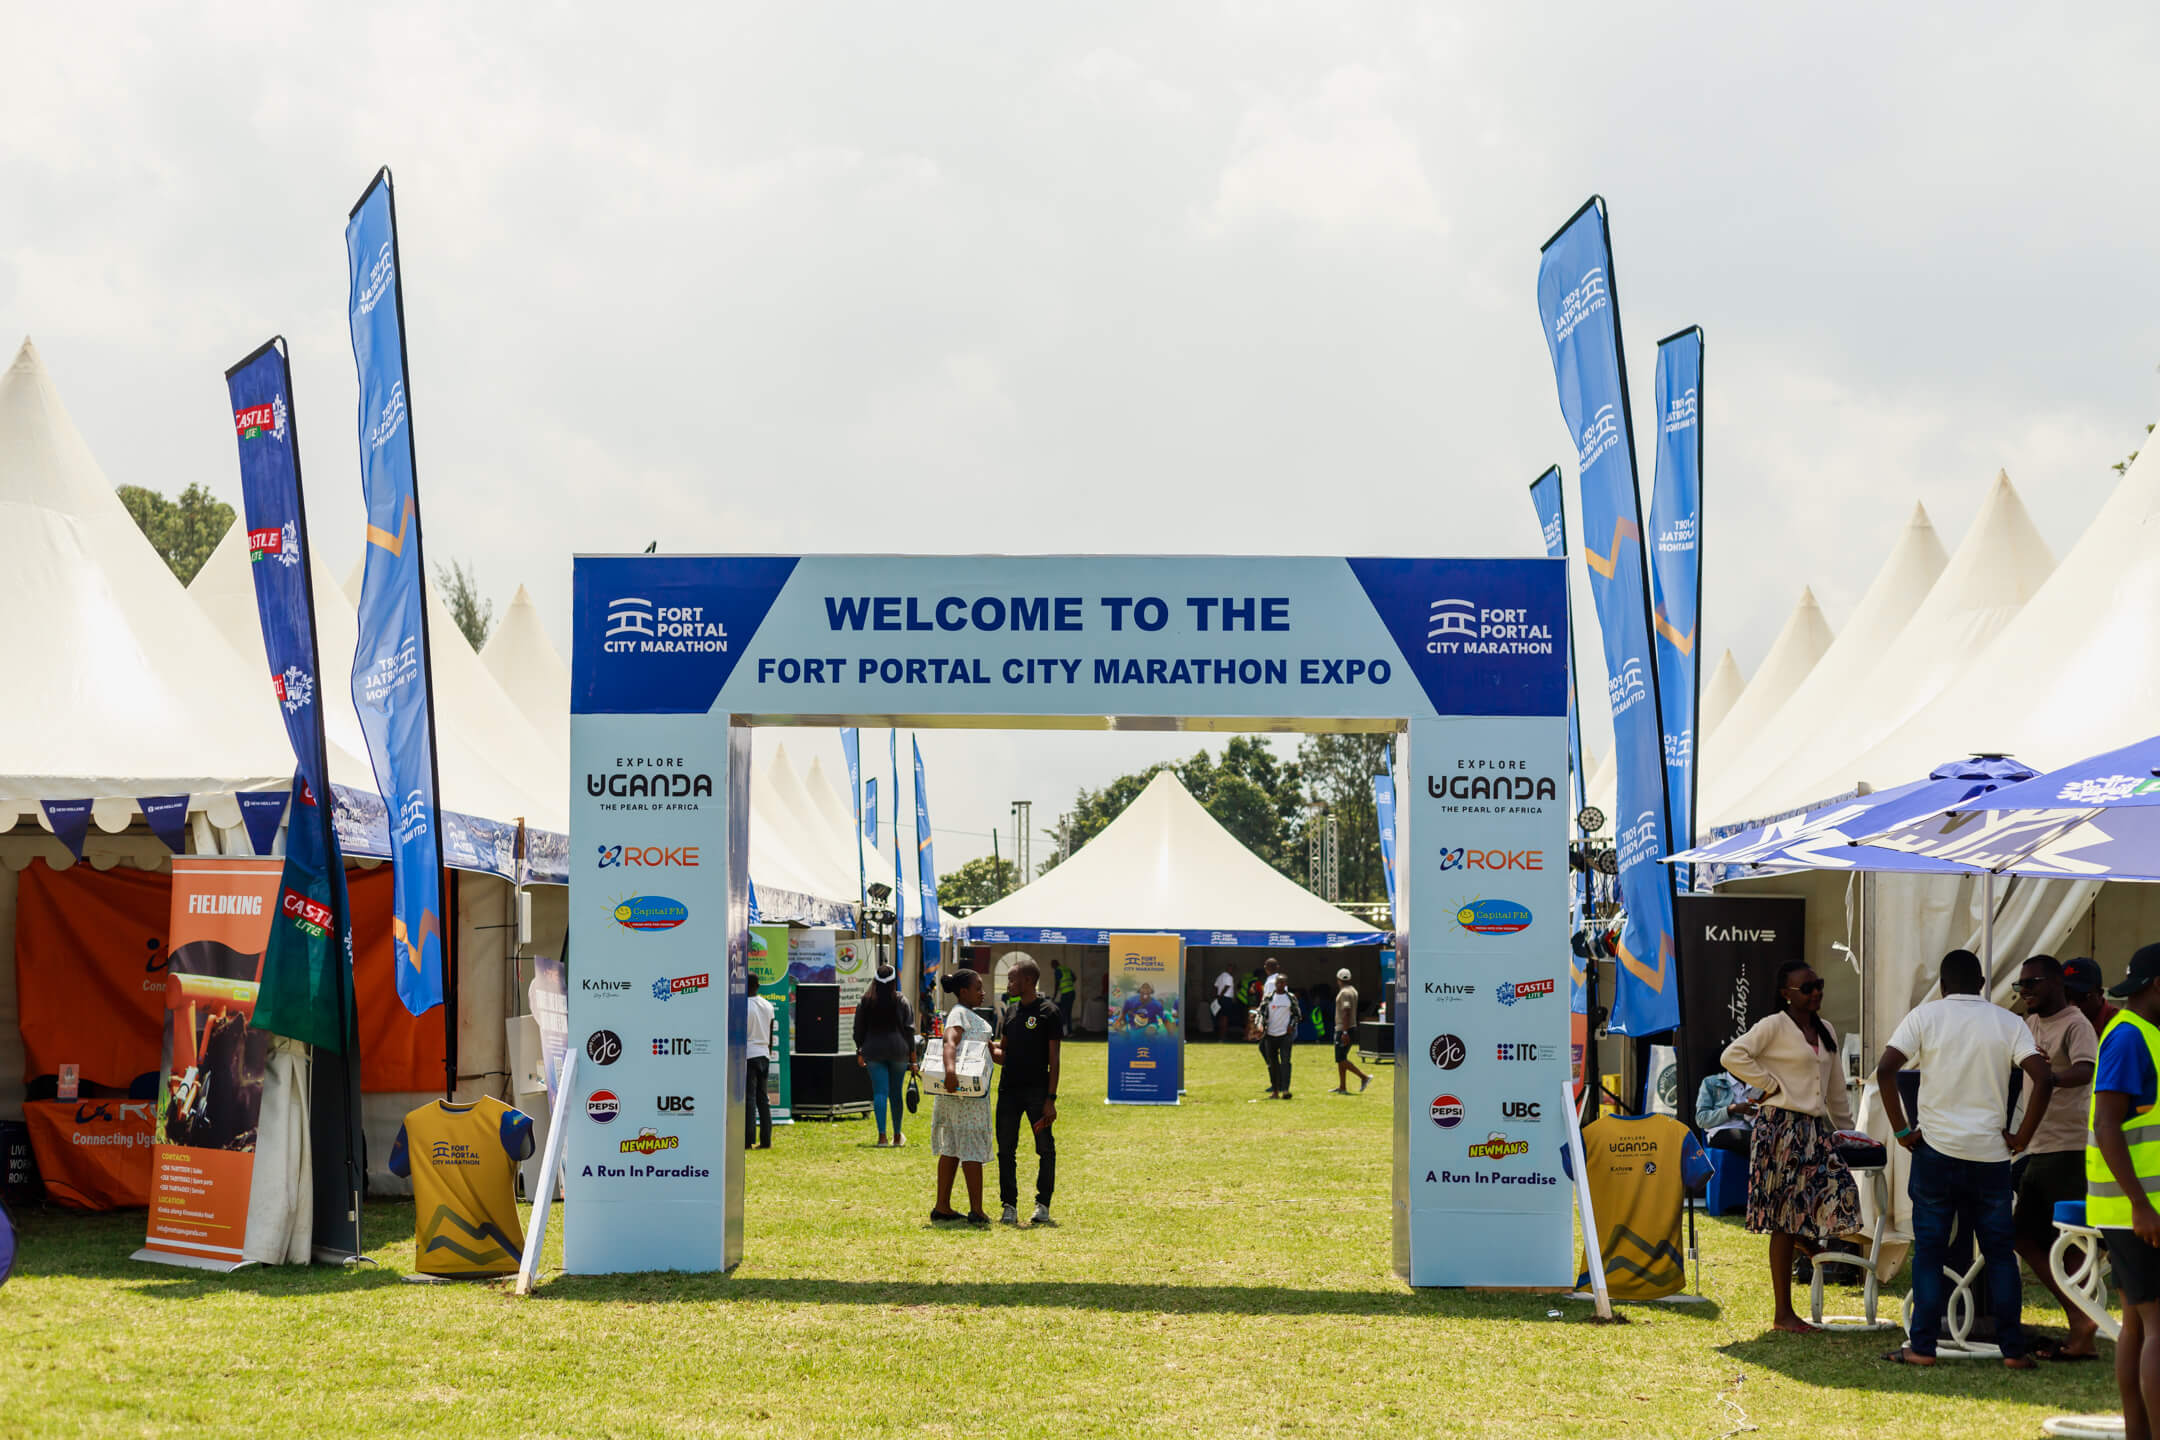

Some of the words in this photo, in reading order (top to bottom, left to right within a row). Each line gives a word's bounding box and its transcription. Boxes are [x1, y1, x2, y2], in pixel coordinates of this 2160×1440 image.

[657, 607, 704, 622] FORT
[824, 596, 1083, 632] WELCOME
[1101, 596, 1169, 632] TO
[1186, 597, 1291, 632] THE
[1480, 608, 1527, 623] FORT
[657, 622, 728, 638] PORTAL
[1480, 623, 1552, 640] PORTAL
[604, 640, 637, 653] CITY
[640, 640, 728, 653] MARATHON
[1426, 641, 1460, 655] CITY
[1463, 641, 1553, 655] MARATHON
[758, 657, 847, 684] FORT
[858, 657, 991, 685] PORTAL
[1002, 657, 1081, 685] CITY
[1093, 658, 1287, 685] MARATHON
[1299, 658, 1392, 686] EXPO
[616, 758, 684, 767] EXPLORE
[1457, 759, 1527, 769] EXPLORE
[587, 774, 712, 797] UGANDA
[1428, 775, 1556, 801] UGANDA
[624, 846, 699, 867] ROKE
[1466, 849, 1544, 870] ROKE
[188, 895, 262, 915] FIELDKING
[284, 895, 334, 930] CASTL
[633, 907, 668, 917] Capital
[669, 907, 685, 916] FM
[1476, 911, 1512, 920] Capital
[1513, 911, 1529, 919] FM
[295, 918, 322, 937] LITE
[673, 974, 708, 989] CASTLE
[1517, 980, 1553, 994] CASTLE
[684, 986, 698, 994] LITE
[671, 1038, 692, 1055] ITC
[1517, 1043, 1537, 1061] ITC
[588, 1103, 618, 1111] PEPSI
[657, 1096, 695, 1111] UBC
[1502, 1102, 1541, 1118] UBC
[1432, 1108, 1462, 1116] PEPSI
[73, 1132, 133, 1148] Connecting
[136, 1132, 157, 1148] Uga
[620, 1136, 679, 1153] NEWMAN'S
[1609, 1142, 1657, 1152] UGANDA
[1469, 1141, 1528, 1158] NEWMAN'S
[582, 1165, 593, 1177] A
[599, 1165, 625, 1177] Run
[630, 1165, 644, 1177] In
[646, 1165, 710, 1178] Paradise
[1426, 1171, 1437, 1183] A
[1442, 1171, 1470, 1184] Run
[1475, 1172, 1489, 1184] In
[1491, 1172, 1557, 1185] Paradise
